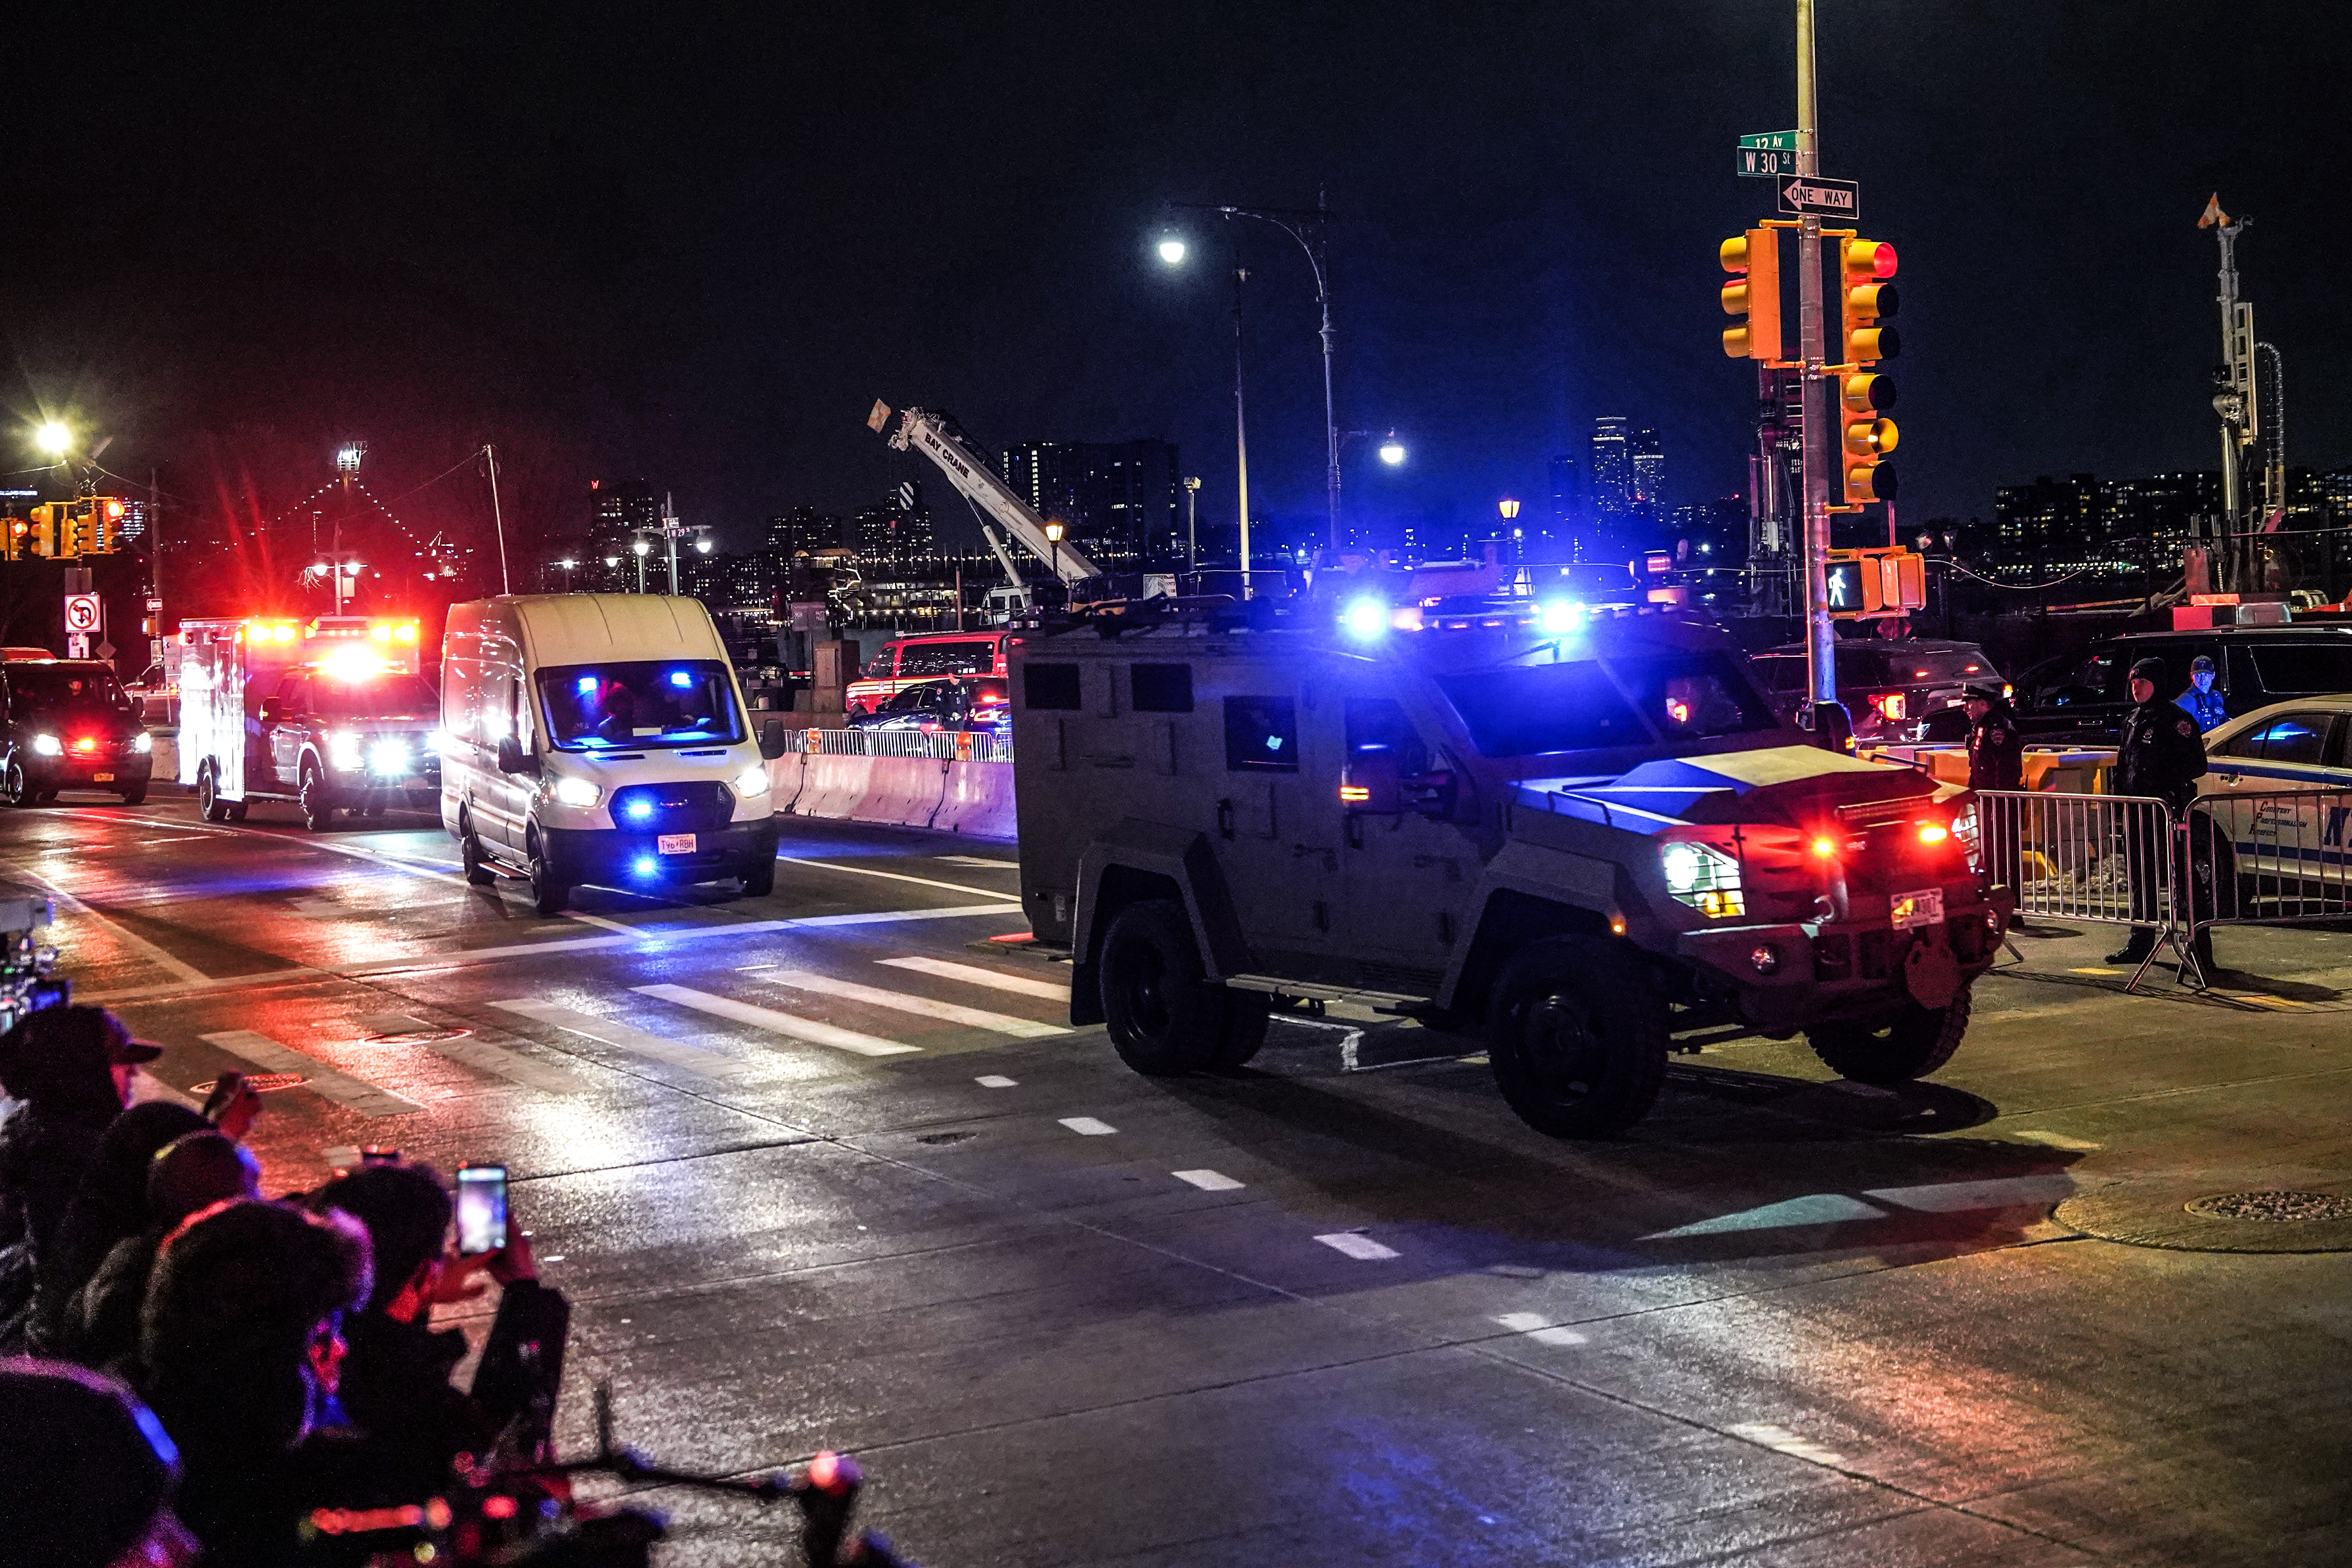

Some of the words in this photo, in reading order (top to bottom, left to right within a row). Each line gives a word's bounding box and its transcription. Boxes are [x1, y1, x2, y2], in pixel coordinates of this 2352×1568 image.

[1756, 137, 1768, 149] 12
[1773, 135, 1782, 147] Av
[1746, 152, 1755, 172] W
[1761, 152, 1777, 173] 30
[1783, 152, 1790, 164] St
[1792, 188, 1814, 202] ONE
[1825, 191, 1847, 206] WAY
[925, 433, 941, 452] BAY
[943, 449, 969, 478] CRANE
[2324, 806, 2352, 848] N
